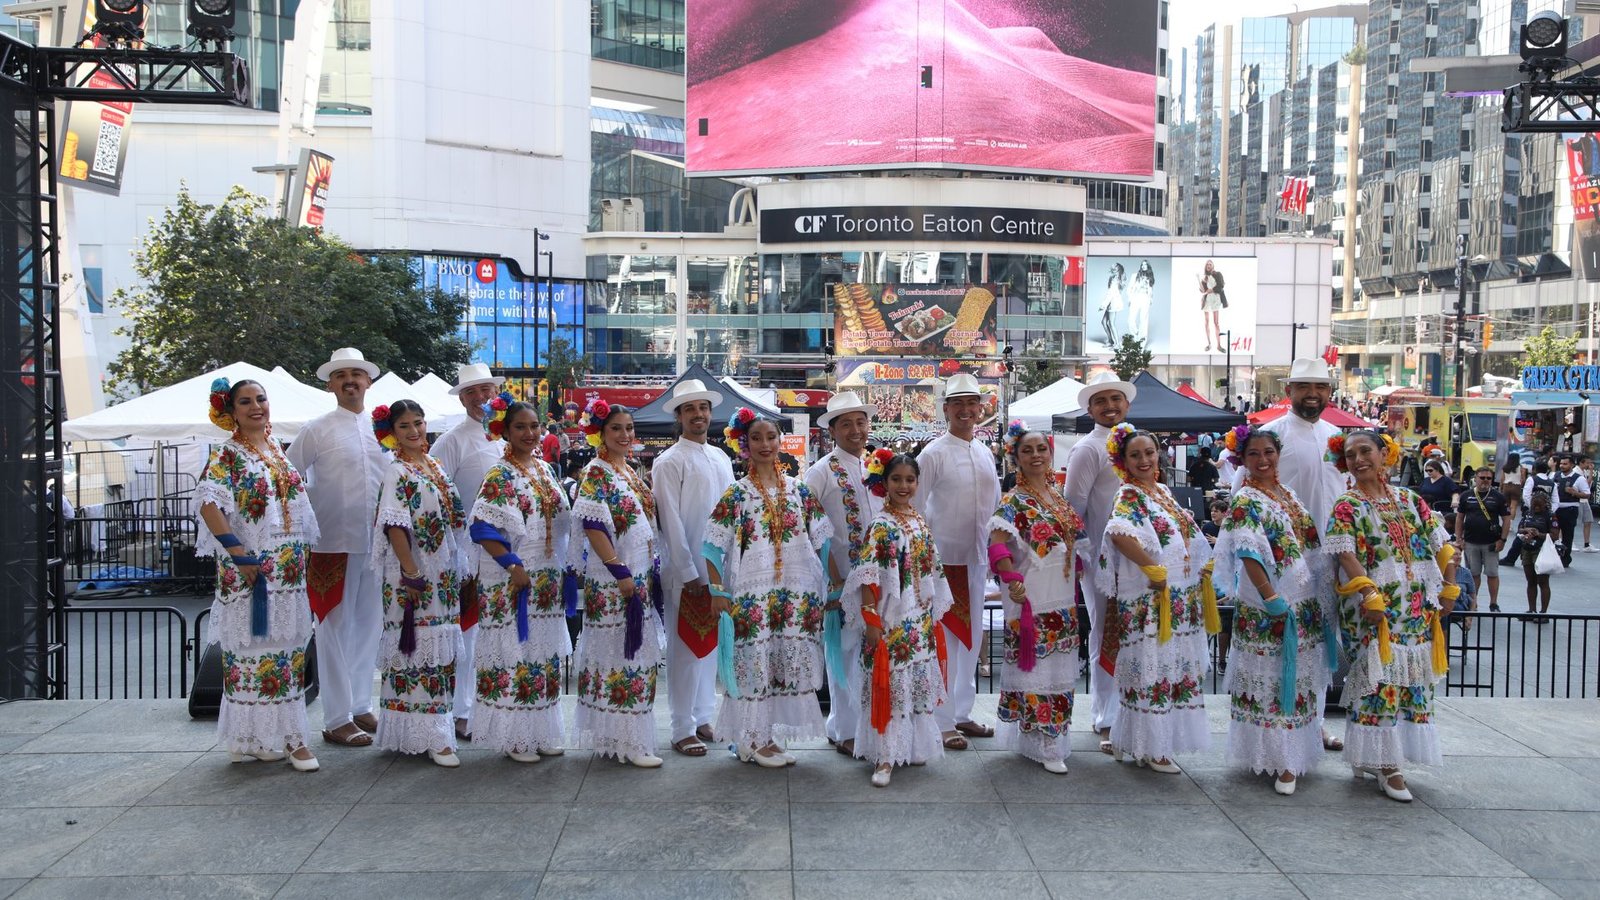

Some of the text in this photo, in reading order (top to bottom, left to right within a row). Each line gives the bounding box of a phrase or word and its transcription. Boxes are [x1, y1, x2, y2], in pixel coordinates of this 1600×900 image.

[794, 214, 1054, 236] CF Toronto Eaton Centre
[438, 263, 473, 276] BMO
[453, 282, 565, 304] eebrae the jys of
[502, 305, 528, 318] with
[843, 329, 895, 338] Potato Tower
[950, 329, 983, 338] Tornado
[843, 339, 919, 348] Sweet Potato Tower
[943, 338, 990, 347] Potato Fries
[1522, 366, 1600, 390] GREEK GYR
